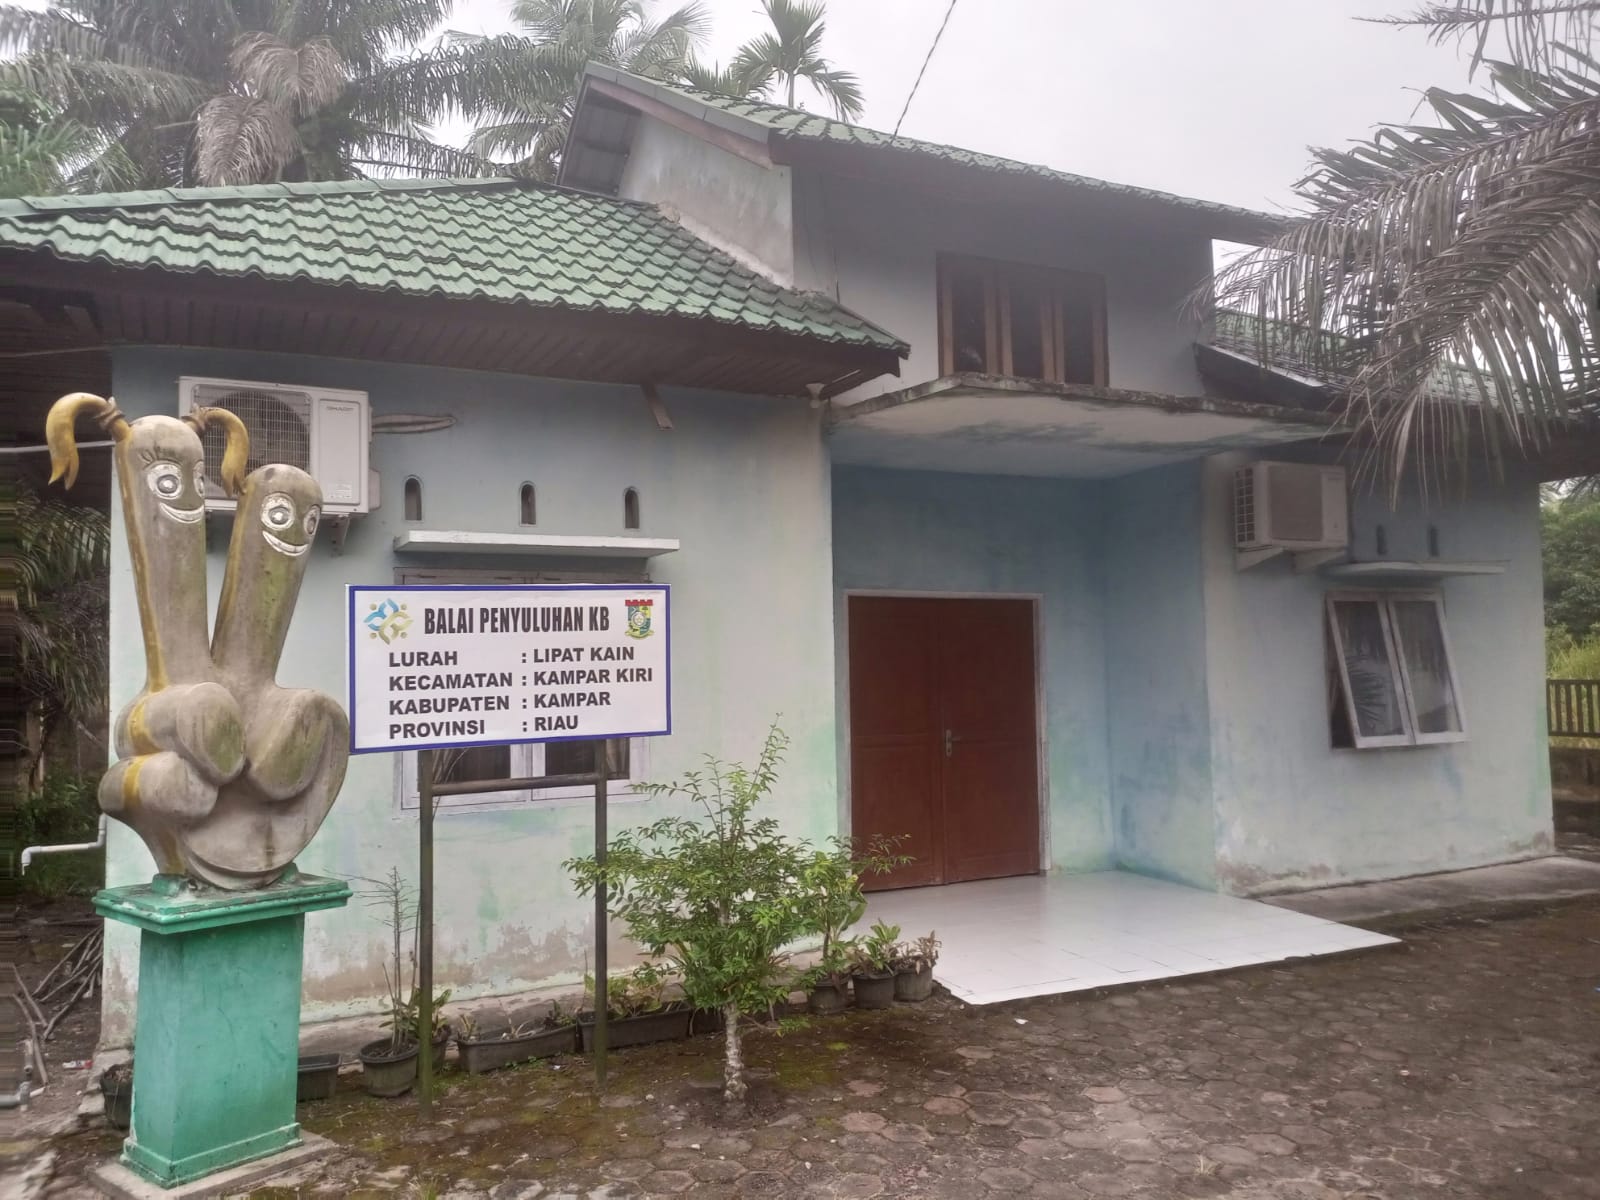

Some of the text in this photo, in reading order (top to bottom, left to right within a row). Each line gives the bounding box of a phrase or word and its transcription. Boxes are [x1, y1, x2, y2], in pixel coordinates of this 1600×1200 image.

[424, 606, 610, 635] BALAI PENYULUHAN KB
[389, 650, 458, 668] LURAH
[533, 647, 585, 664] LIPAT
[590, 646, 635, 662] KAIN
[389, 672, 513, 691] KECAMATAN
[533, 669, 611, 686] KAMPAR
[616, 667, 653, 683] KIRI
[389, 695, 510, 716] KABUPATEN
[534, 691, 612, 709] KAMPAR
[389, 719, 486, 740] PROVINSI
[534, 714, 579, 732] RIAU
